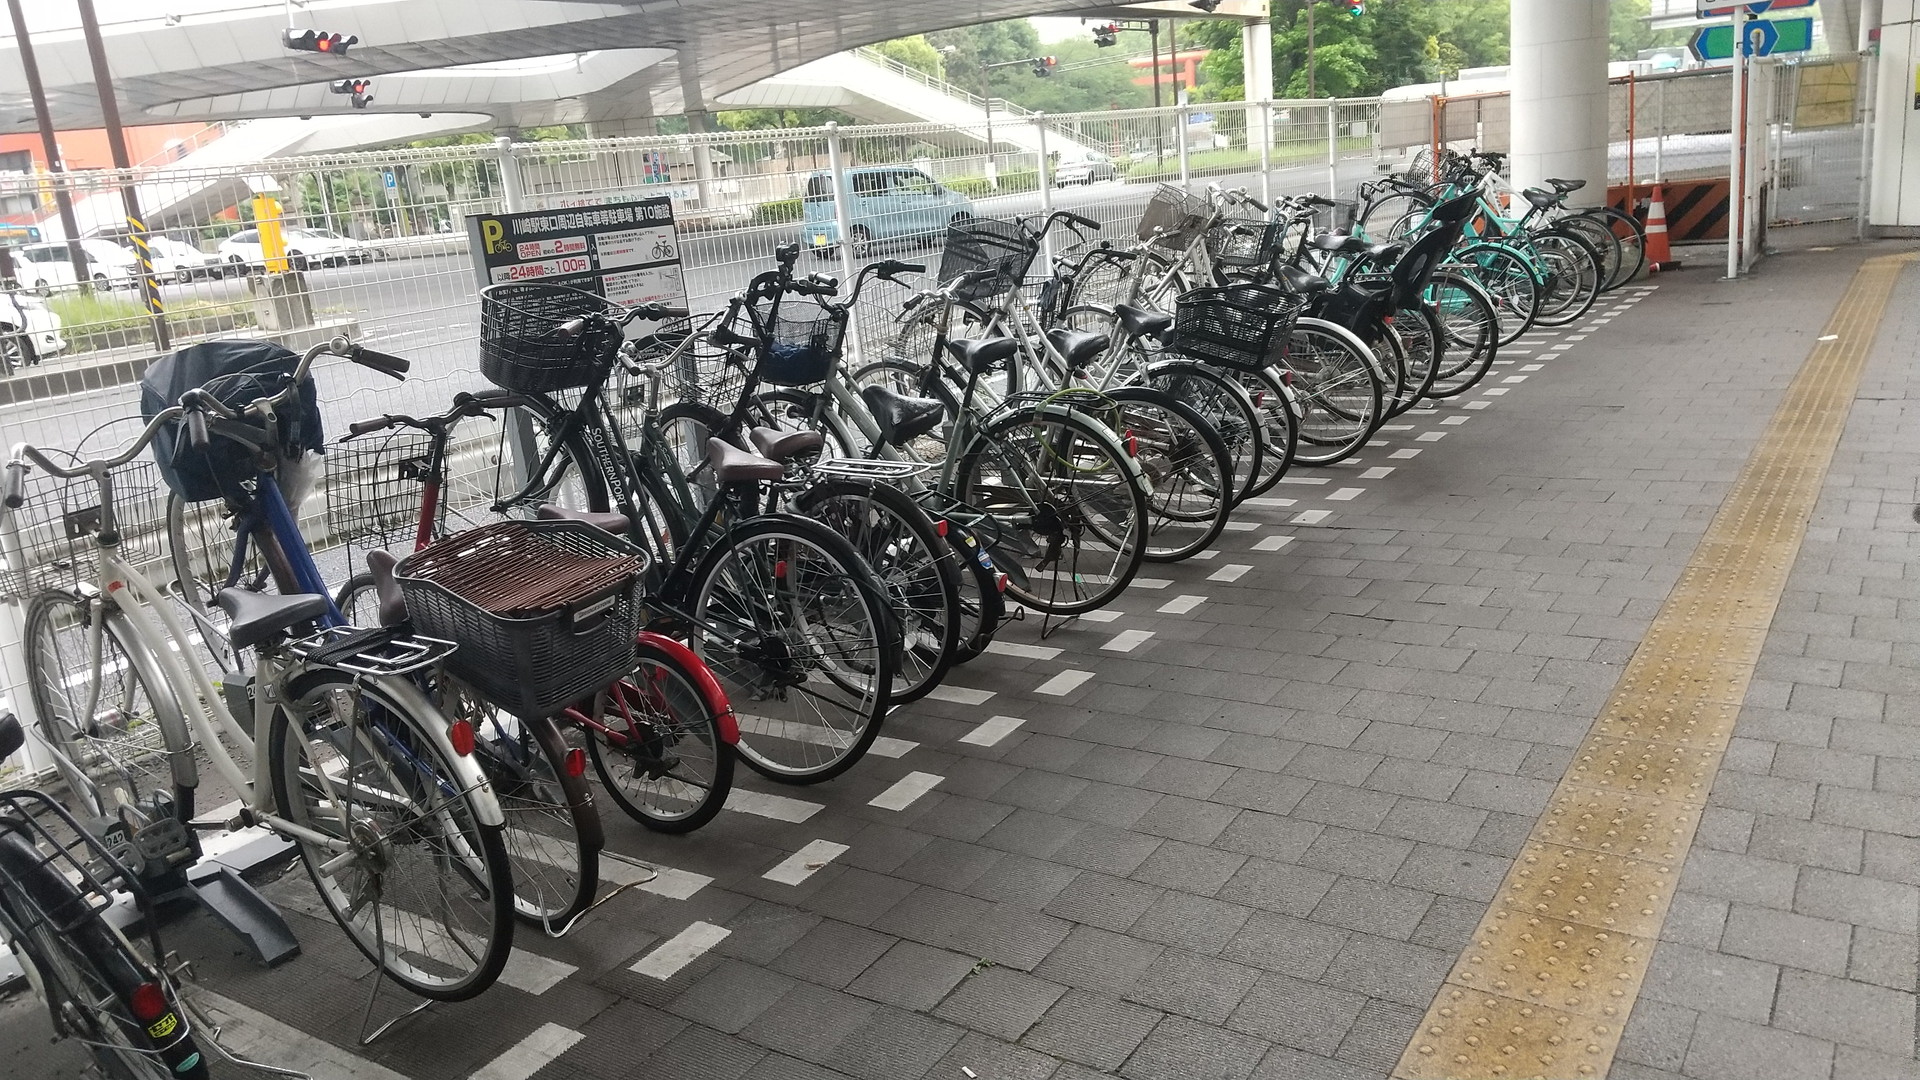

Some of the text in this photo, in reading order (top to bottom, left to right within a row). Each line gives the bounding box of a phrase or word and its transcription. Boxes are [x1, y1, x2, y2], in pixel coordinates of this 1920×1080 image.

[386, 173, 394, 187] P
[634, 203, 671, 222] 第10施設
[481, 219, 504, 255] P
[518, 242, 541, 252] 24時間
[520, 250, 542, 259] OPEN
[105, 832, 124, 849] 242
